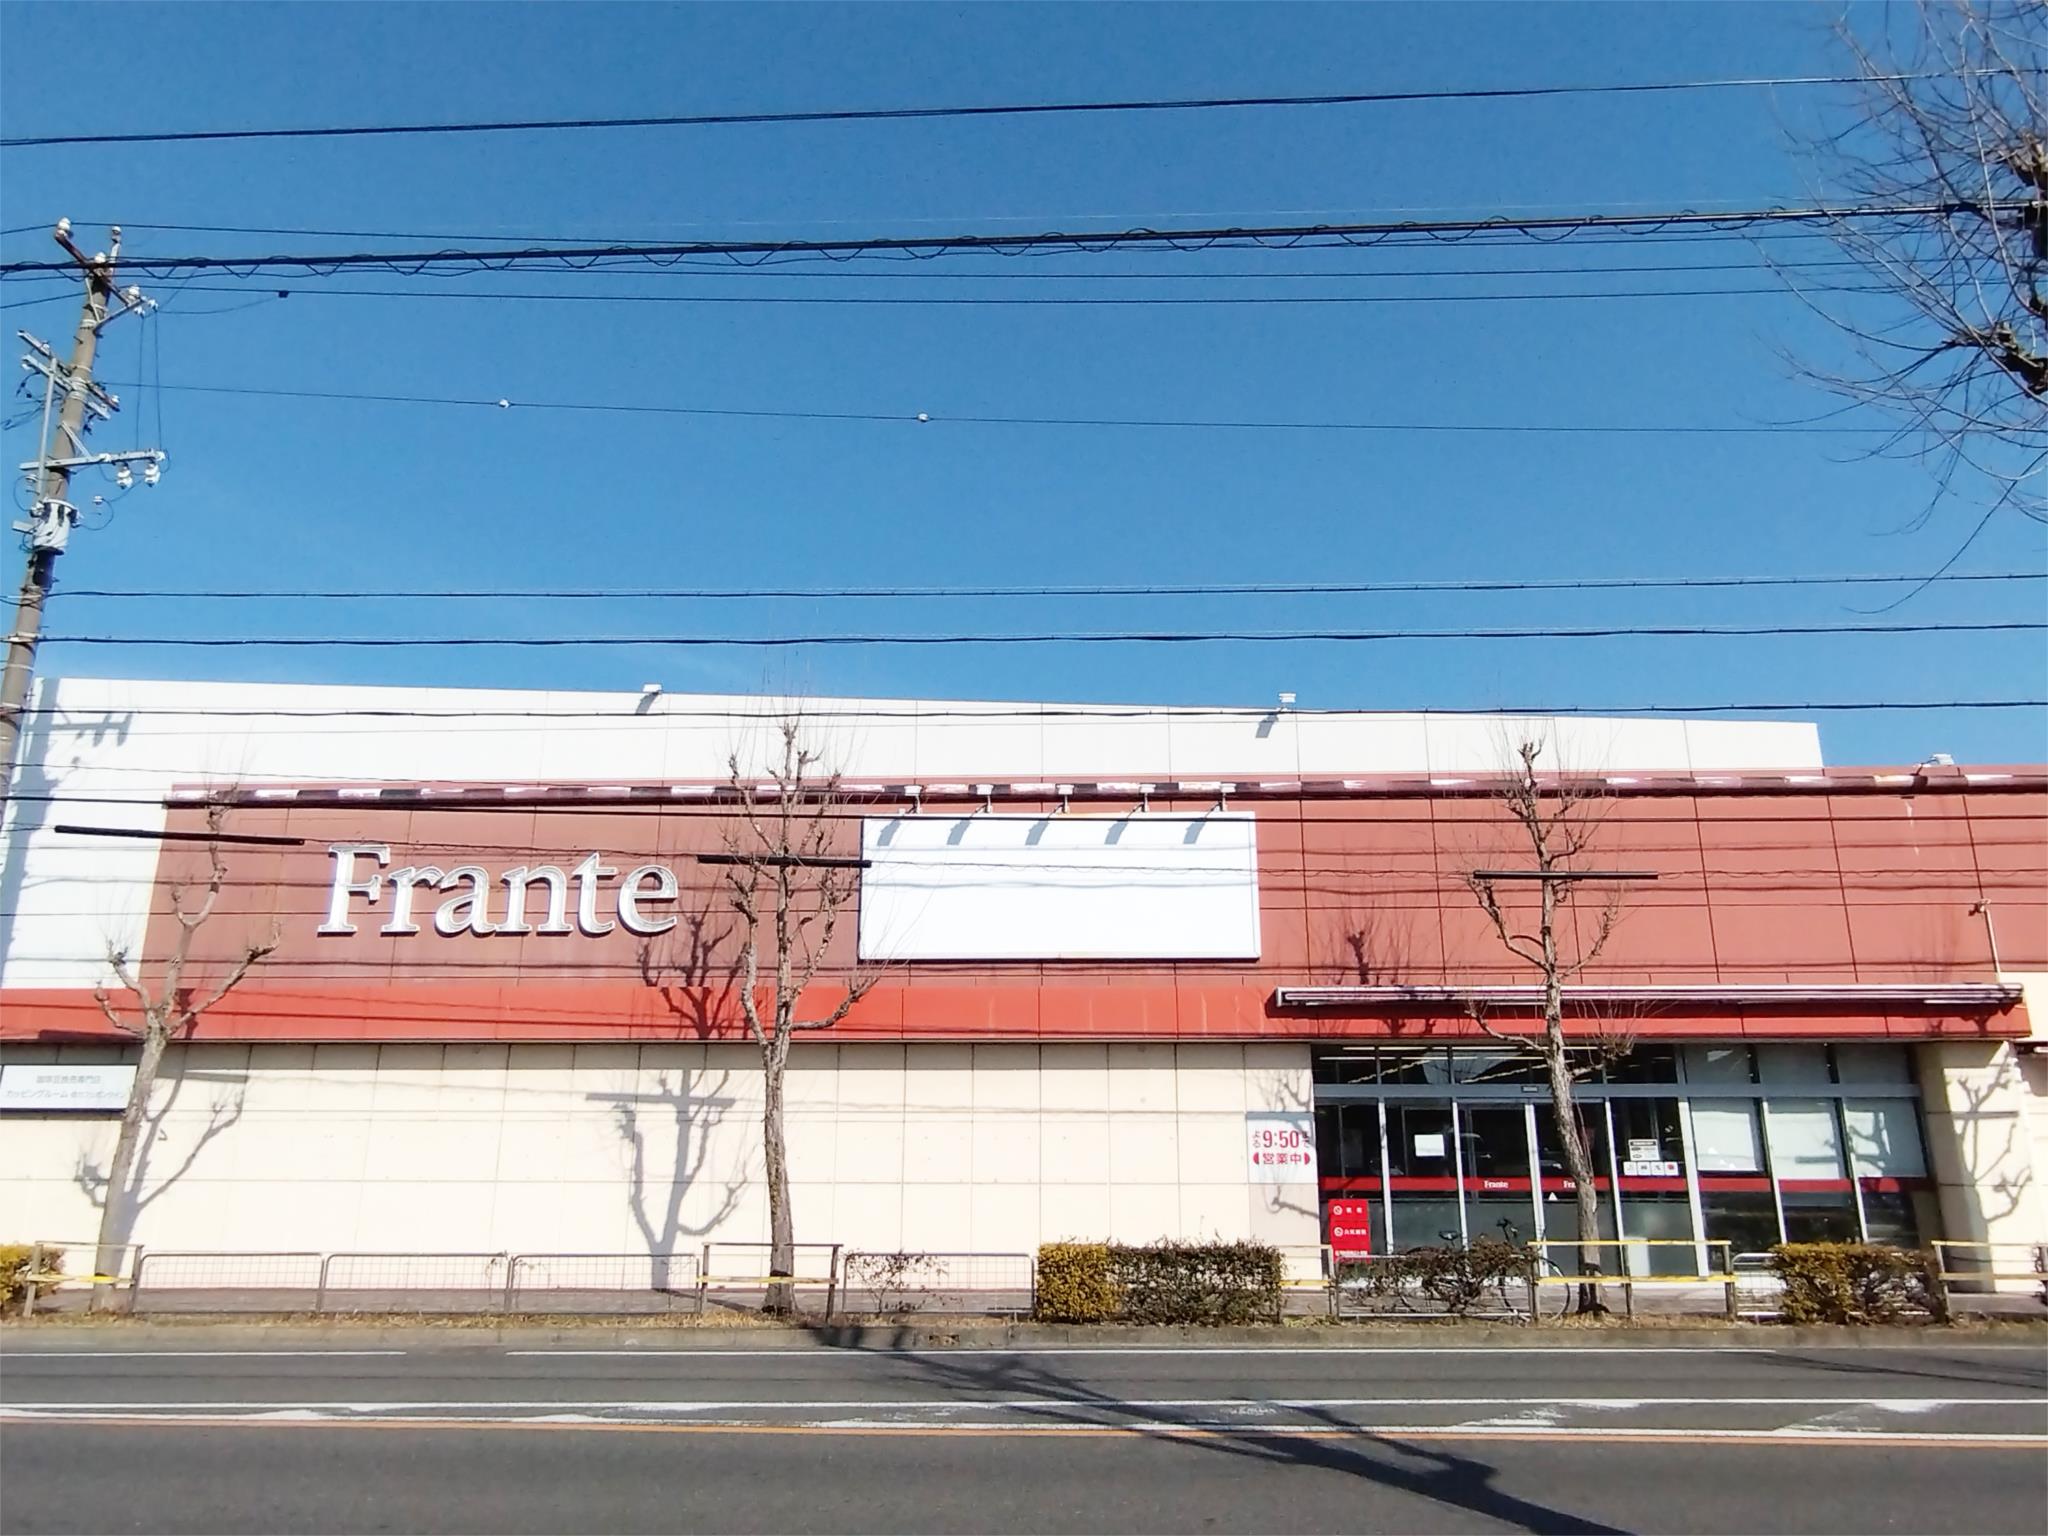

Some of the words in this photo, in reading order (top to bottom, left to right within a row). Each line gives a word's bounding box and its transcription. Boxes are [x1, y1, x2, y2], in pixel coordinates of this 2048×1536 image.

[317, 843, 679, 937] Frante
[1263, 1130, 1299, 1148] 9:50
[1262, 1152, 1302, 1165] 営業中
[1484, 1180, 1508, 1188] Frante
[1564, 1180, 1576, 1188] Fra
